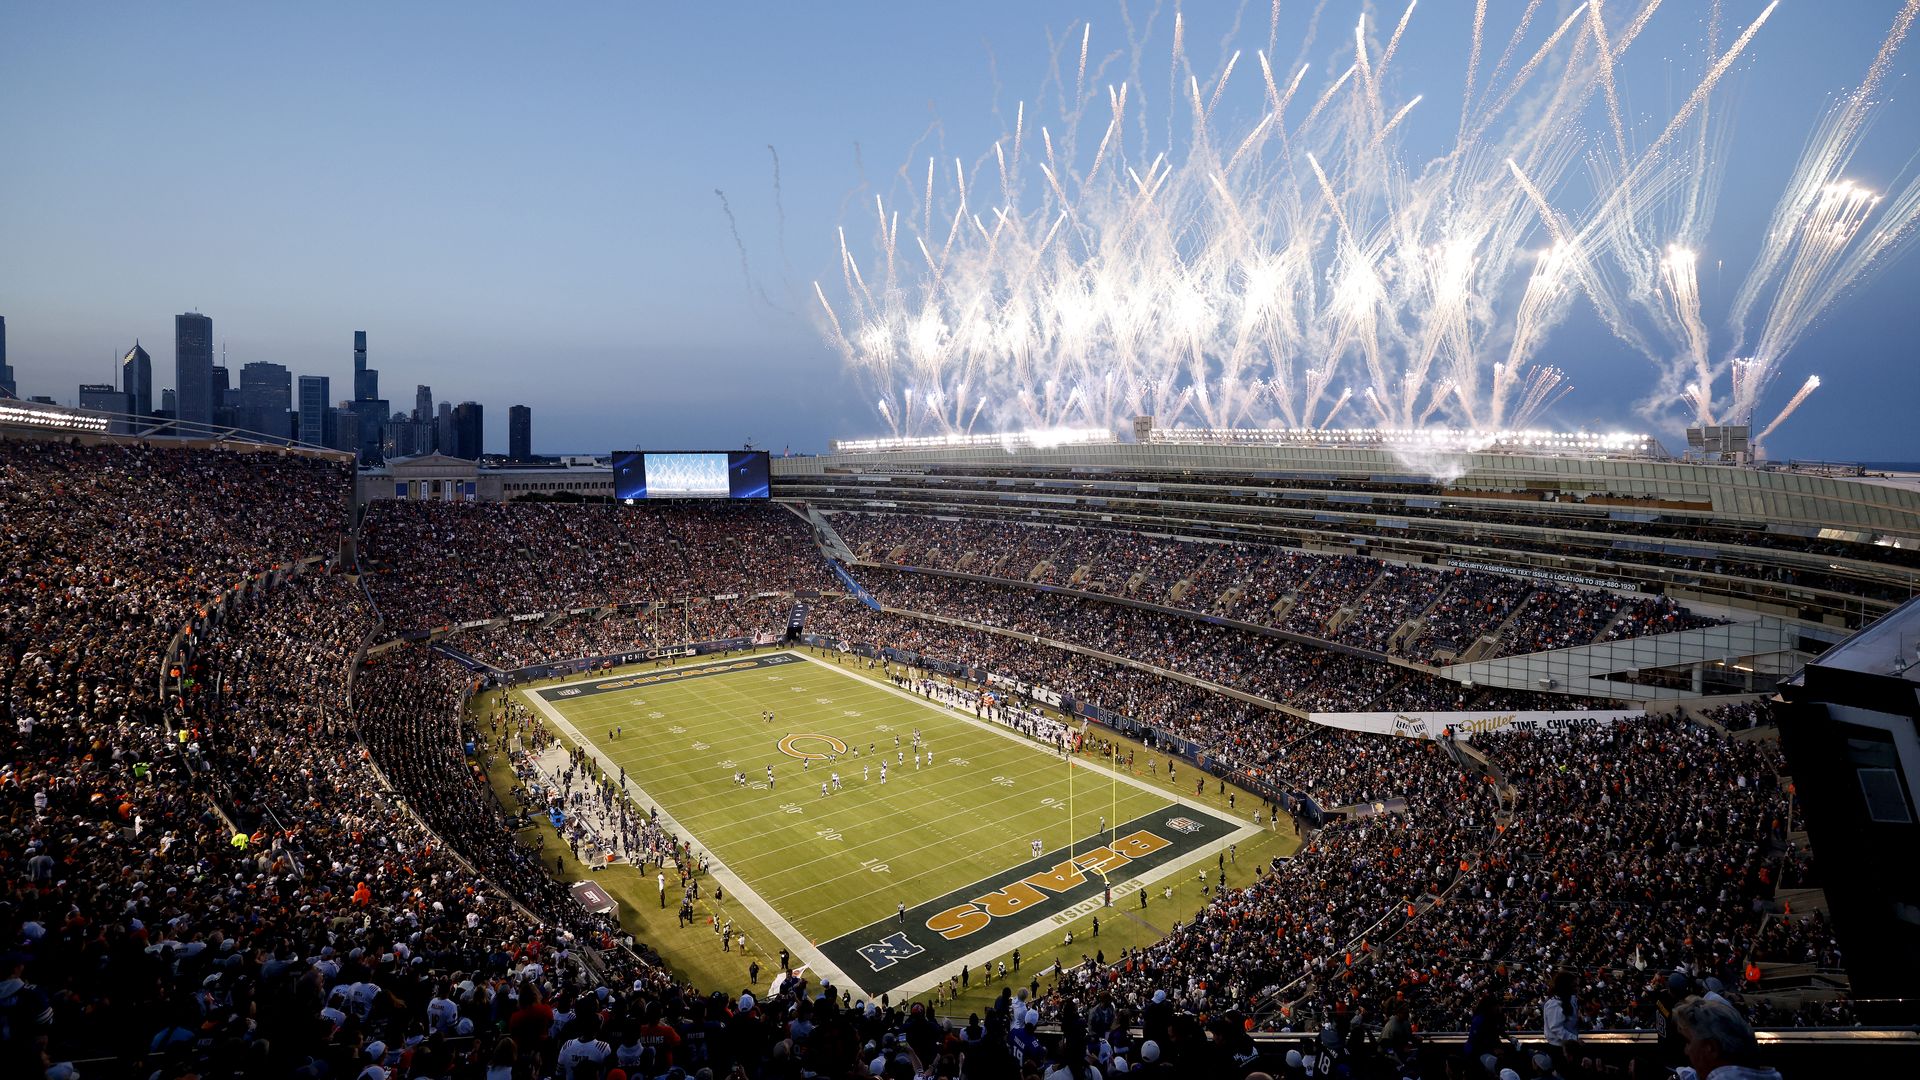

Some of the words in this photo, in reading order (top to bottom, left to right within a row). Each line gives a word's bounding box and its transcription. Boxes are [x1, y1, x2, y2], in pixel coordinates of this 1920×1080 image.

[1459, 561, 1517, 575] SECURITY/ASSISTANCE
[1532, 571, 1548, 579] ISSUE
[1554, 574, 1584, 584] LOCATION
[1395, 720, 1409, 730] Lite
[1463, 714, 1518, 738] Miller
[816, 827, 842, 841] 20
[860, 858, 889, 873] 10
[925, 829, 1173, 941] BEARS
[1113, 879, 1145, 895] END
[1318, 1051, 1331, 1075] 18
